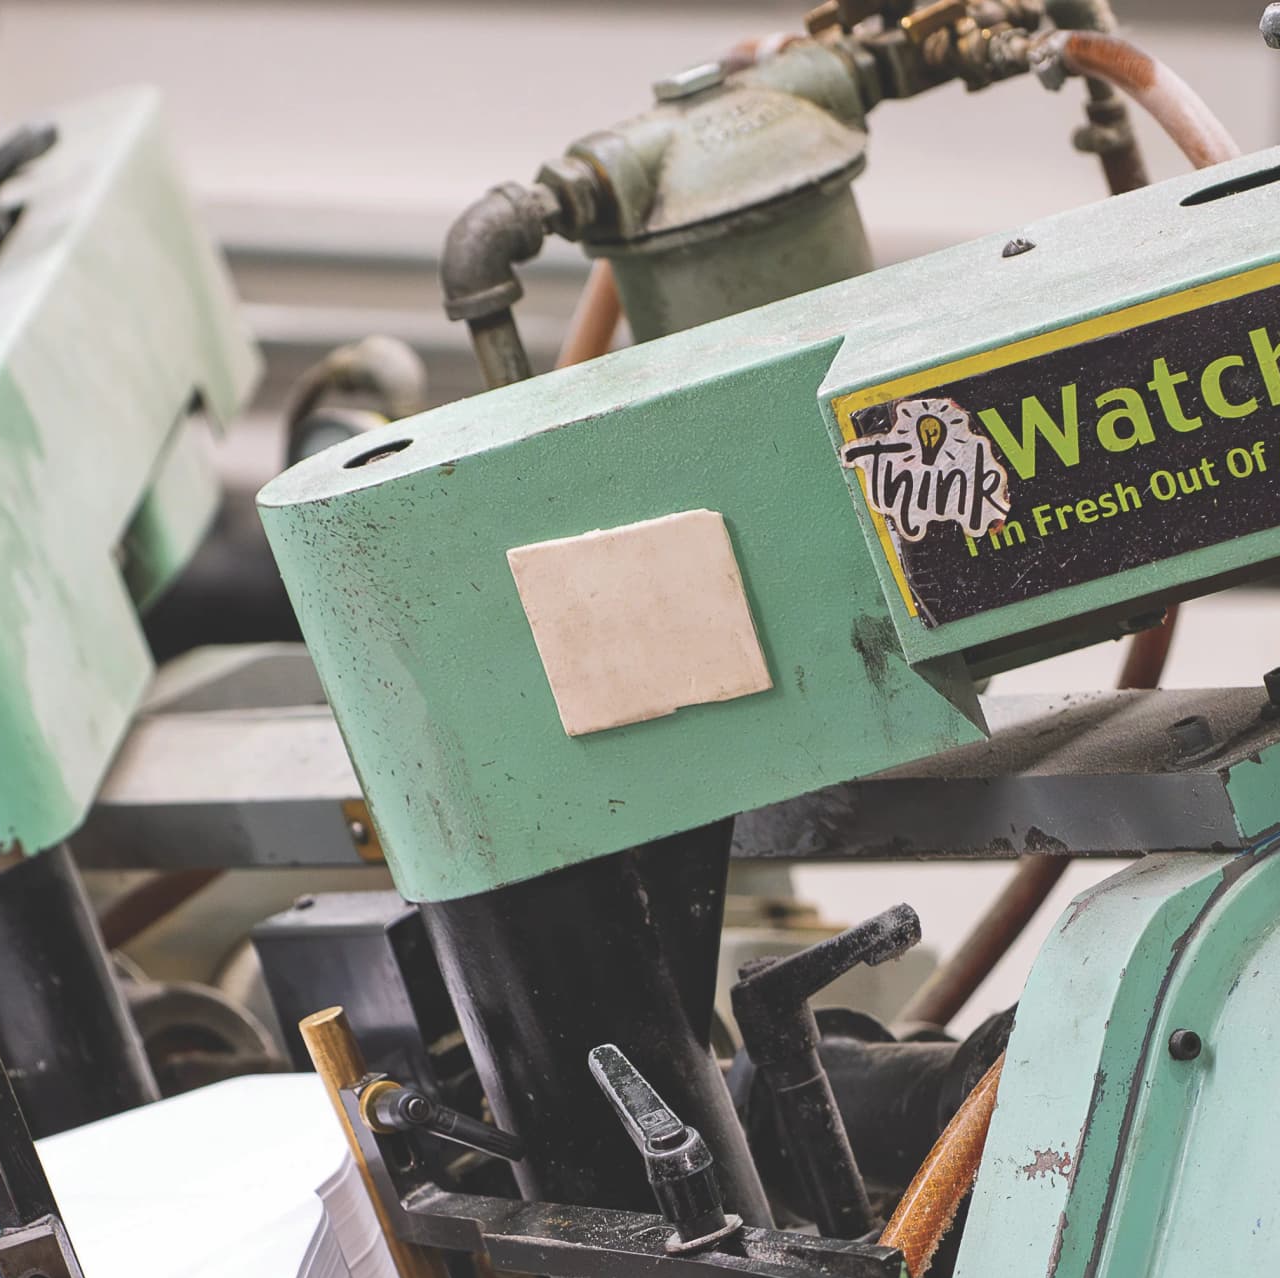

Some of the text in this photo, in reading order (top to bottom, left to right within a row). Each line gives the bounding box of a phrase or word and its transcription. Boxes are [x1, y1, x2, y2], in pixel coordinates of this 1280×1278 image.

[845, 441, 1009, 536] Think
[1031, 482, 1143, 537] Fresh
[1150, 457, 1220, 501] Out
[1226, 441, 1268, 479] Of
